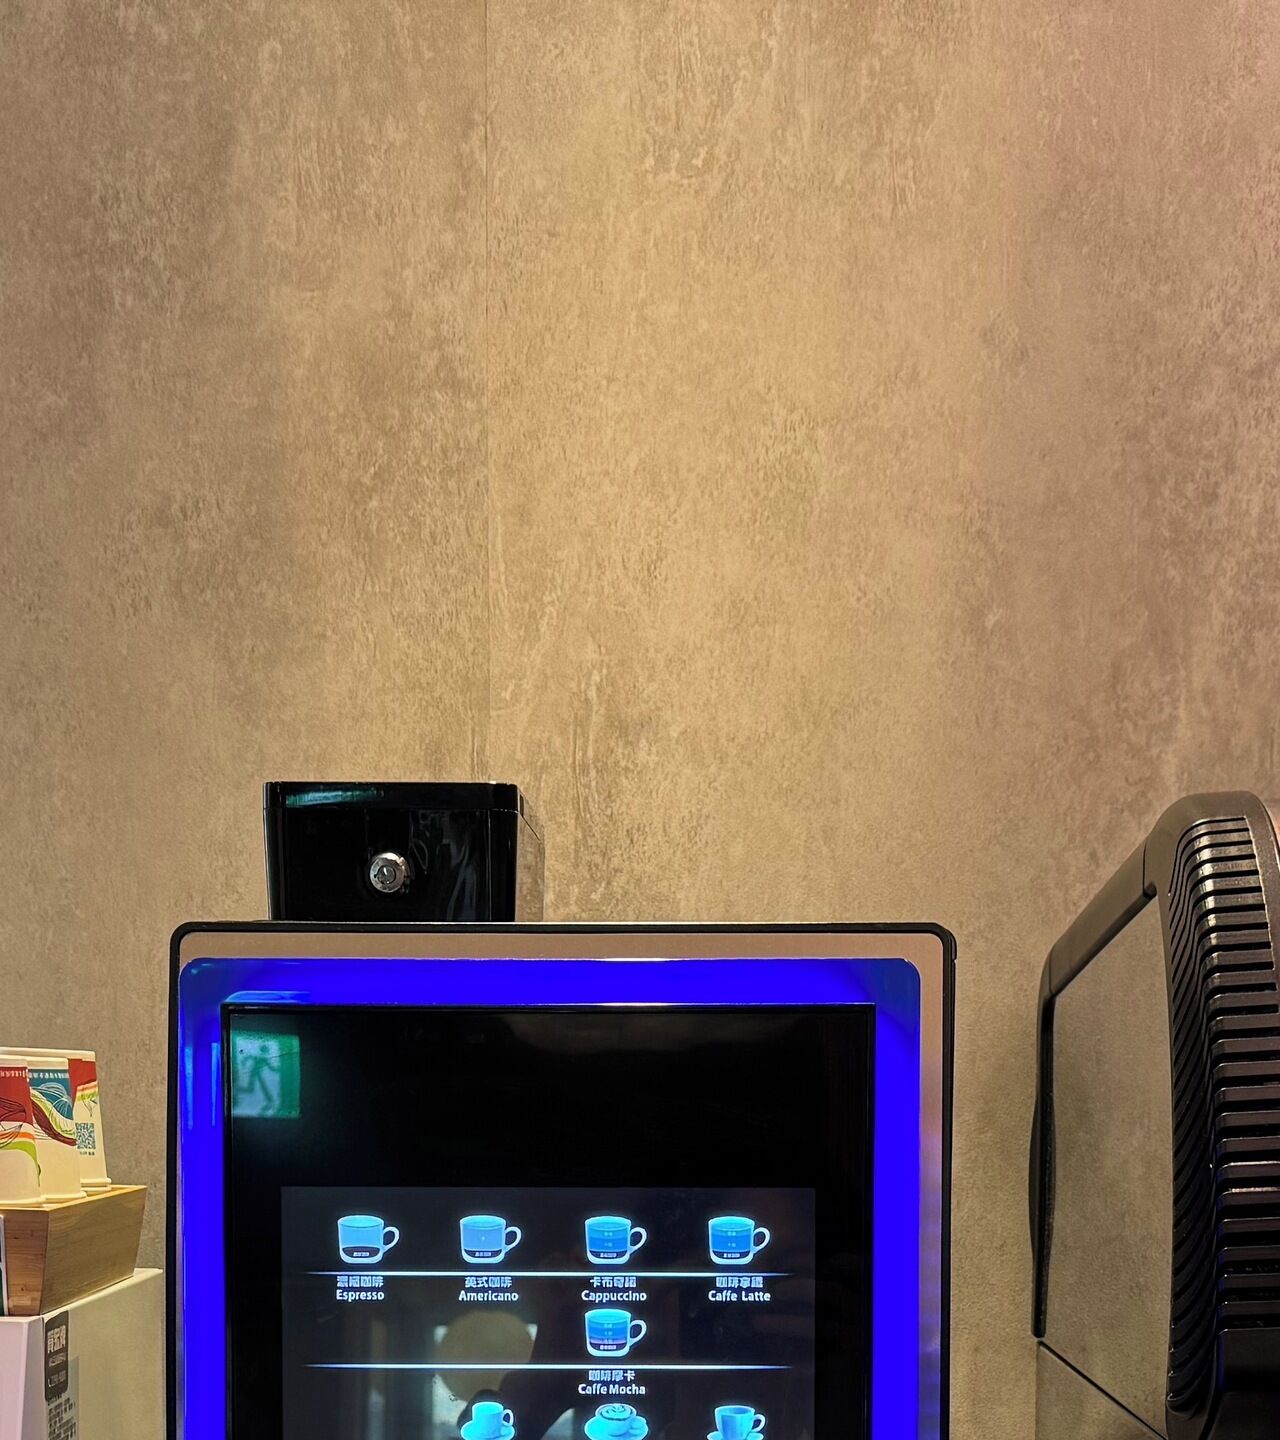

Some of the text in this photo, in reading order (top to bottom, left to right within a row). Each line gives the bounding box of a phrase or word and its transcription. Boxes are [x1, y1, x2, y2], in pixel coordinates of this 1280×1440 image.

[336, 1289, 385, 1302] Espresso
[458, 1290, 519, 1301] Americano
[581, 1289, 647, 1303] Cappuccino
[708, 1290, 771, 1302] Caffe Latte
[578, 1383, 646, 1395] Caffe Mocha
